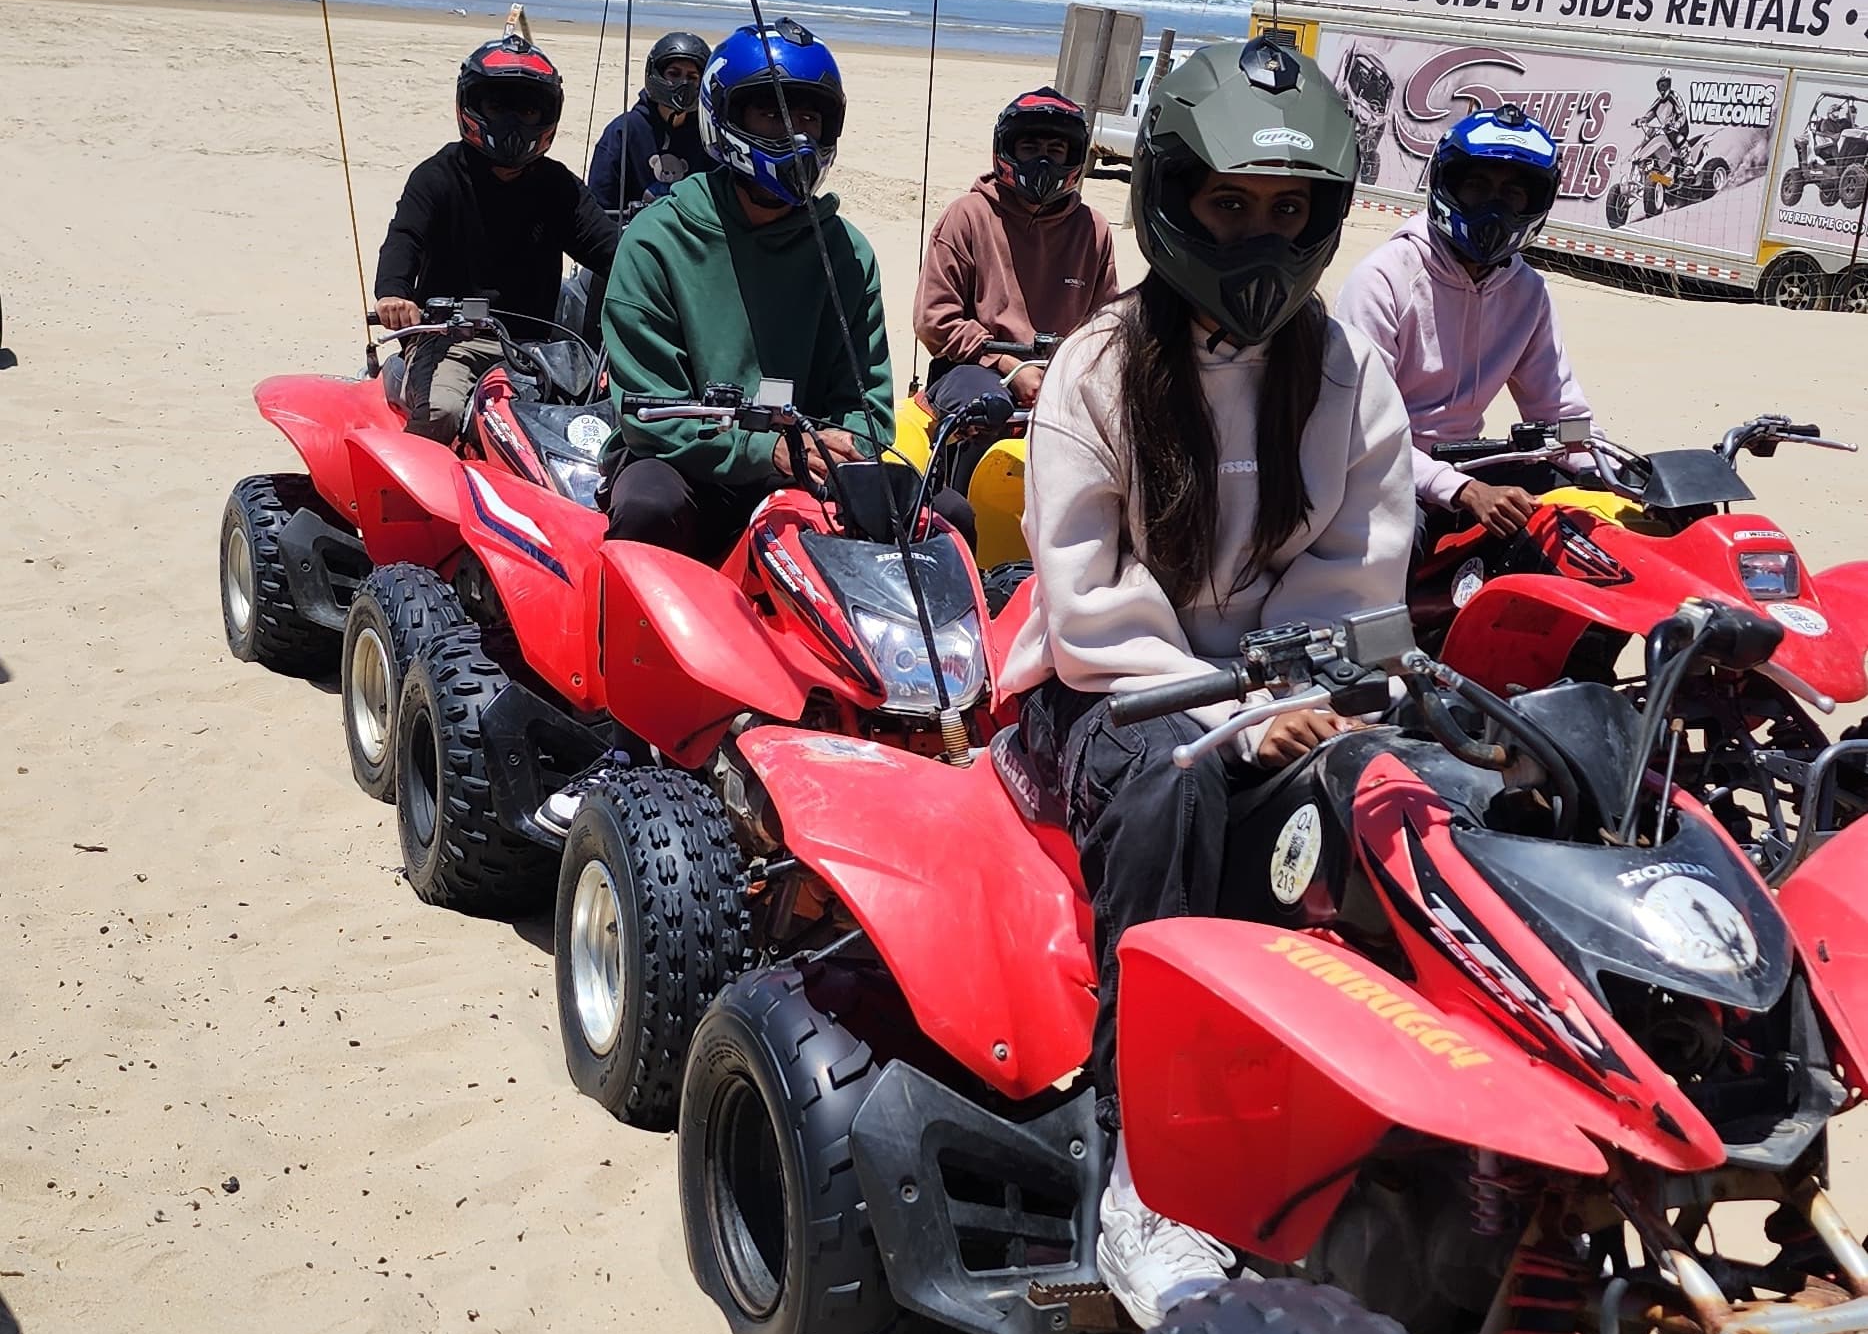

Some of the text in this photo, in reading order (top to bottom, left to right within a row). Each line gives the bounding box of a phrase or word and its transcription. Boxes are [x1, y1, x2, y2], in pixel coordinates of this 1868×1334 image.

[1690, 82, 1776, 106] WALK-UPS
[1689, 102, 1772, 127] WELCOME
[1779, 209, 1794, 224] WE
[1794, 212, 1817, 227] RENT
[1817, 216, 1835, 230] THE
[1616, 862, 1720, 888] HONDA
[1430, 892, 1602, 1059] TRX
[1262, 935, 1494, 1069] SUNBUGGY
